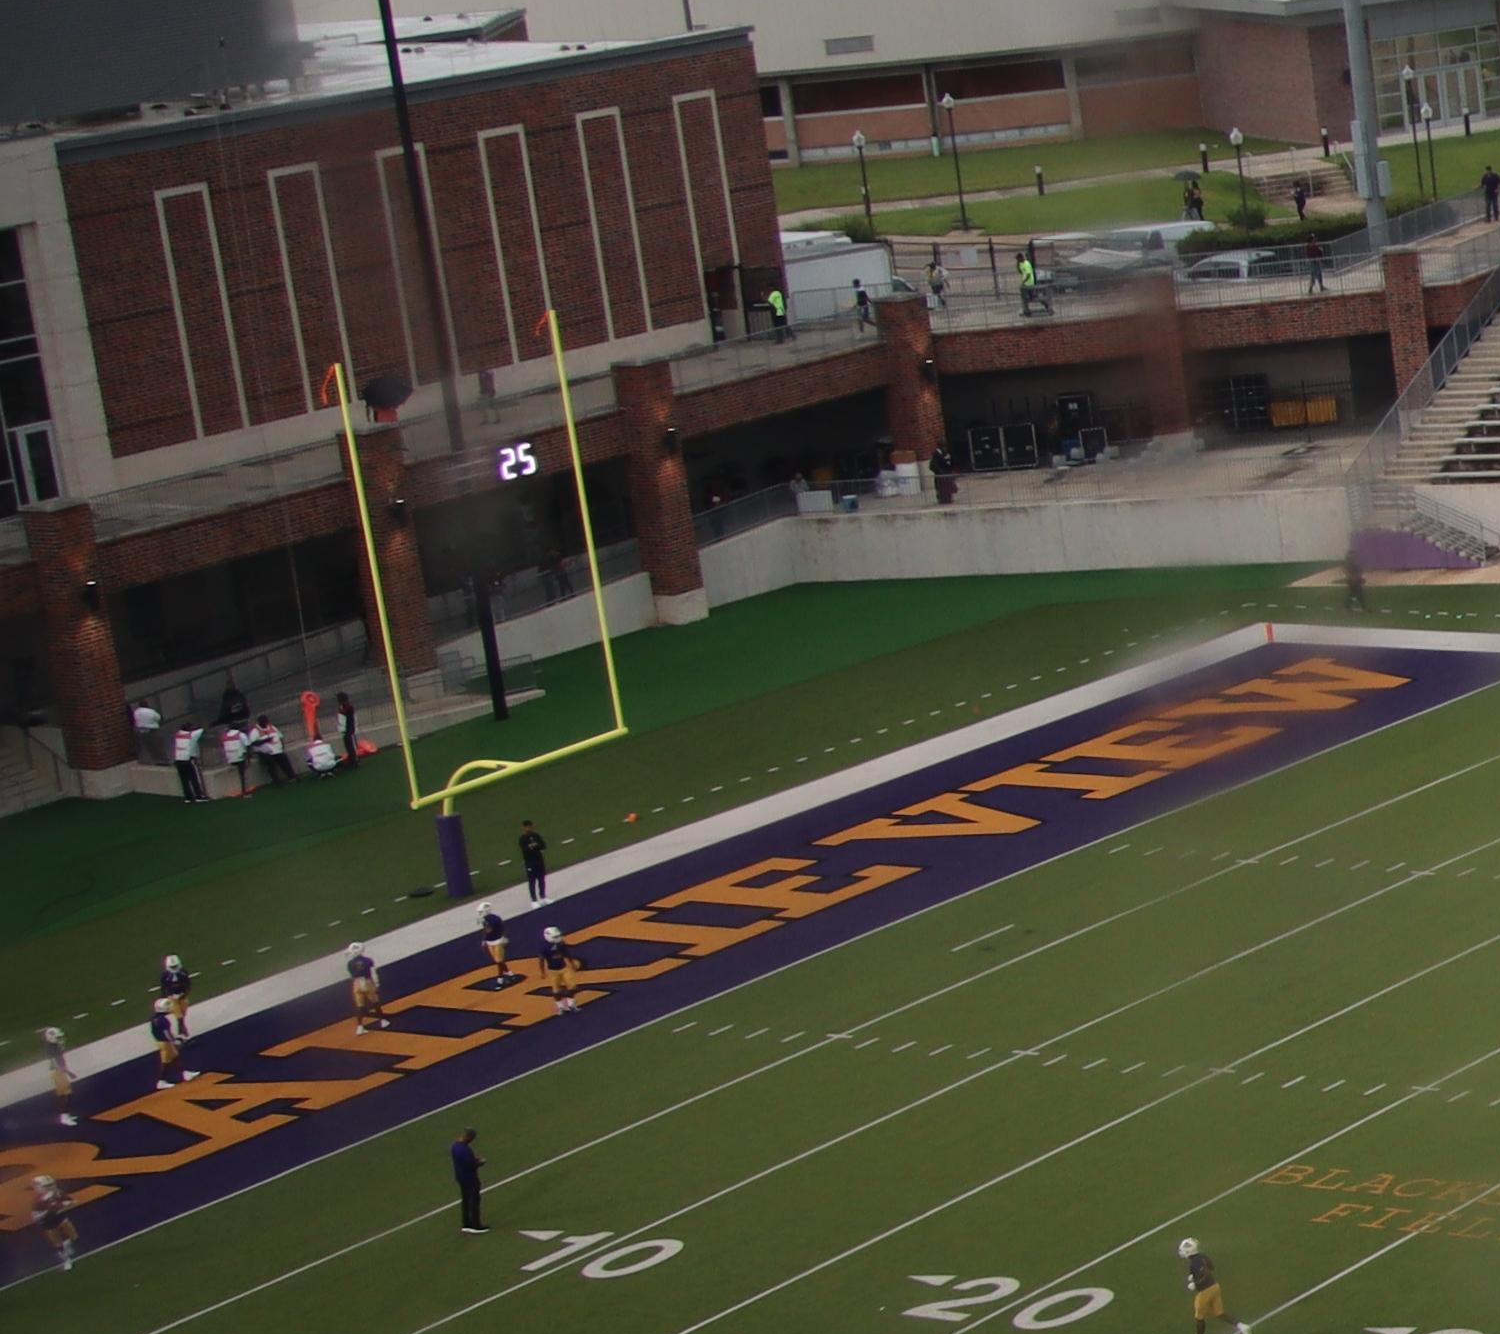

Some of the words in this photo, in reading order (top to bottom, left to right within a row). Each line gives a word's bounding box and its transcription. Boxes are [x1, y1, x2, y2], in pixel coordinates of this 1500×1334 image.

[500, 442, 536, 480] 25
[812, 657, 1413, 846] VIEW
[520, 1231, 684, 1279] 10
[901, 1276, 1115, 1331] 20
